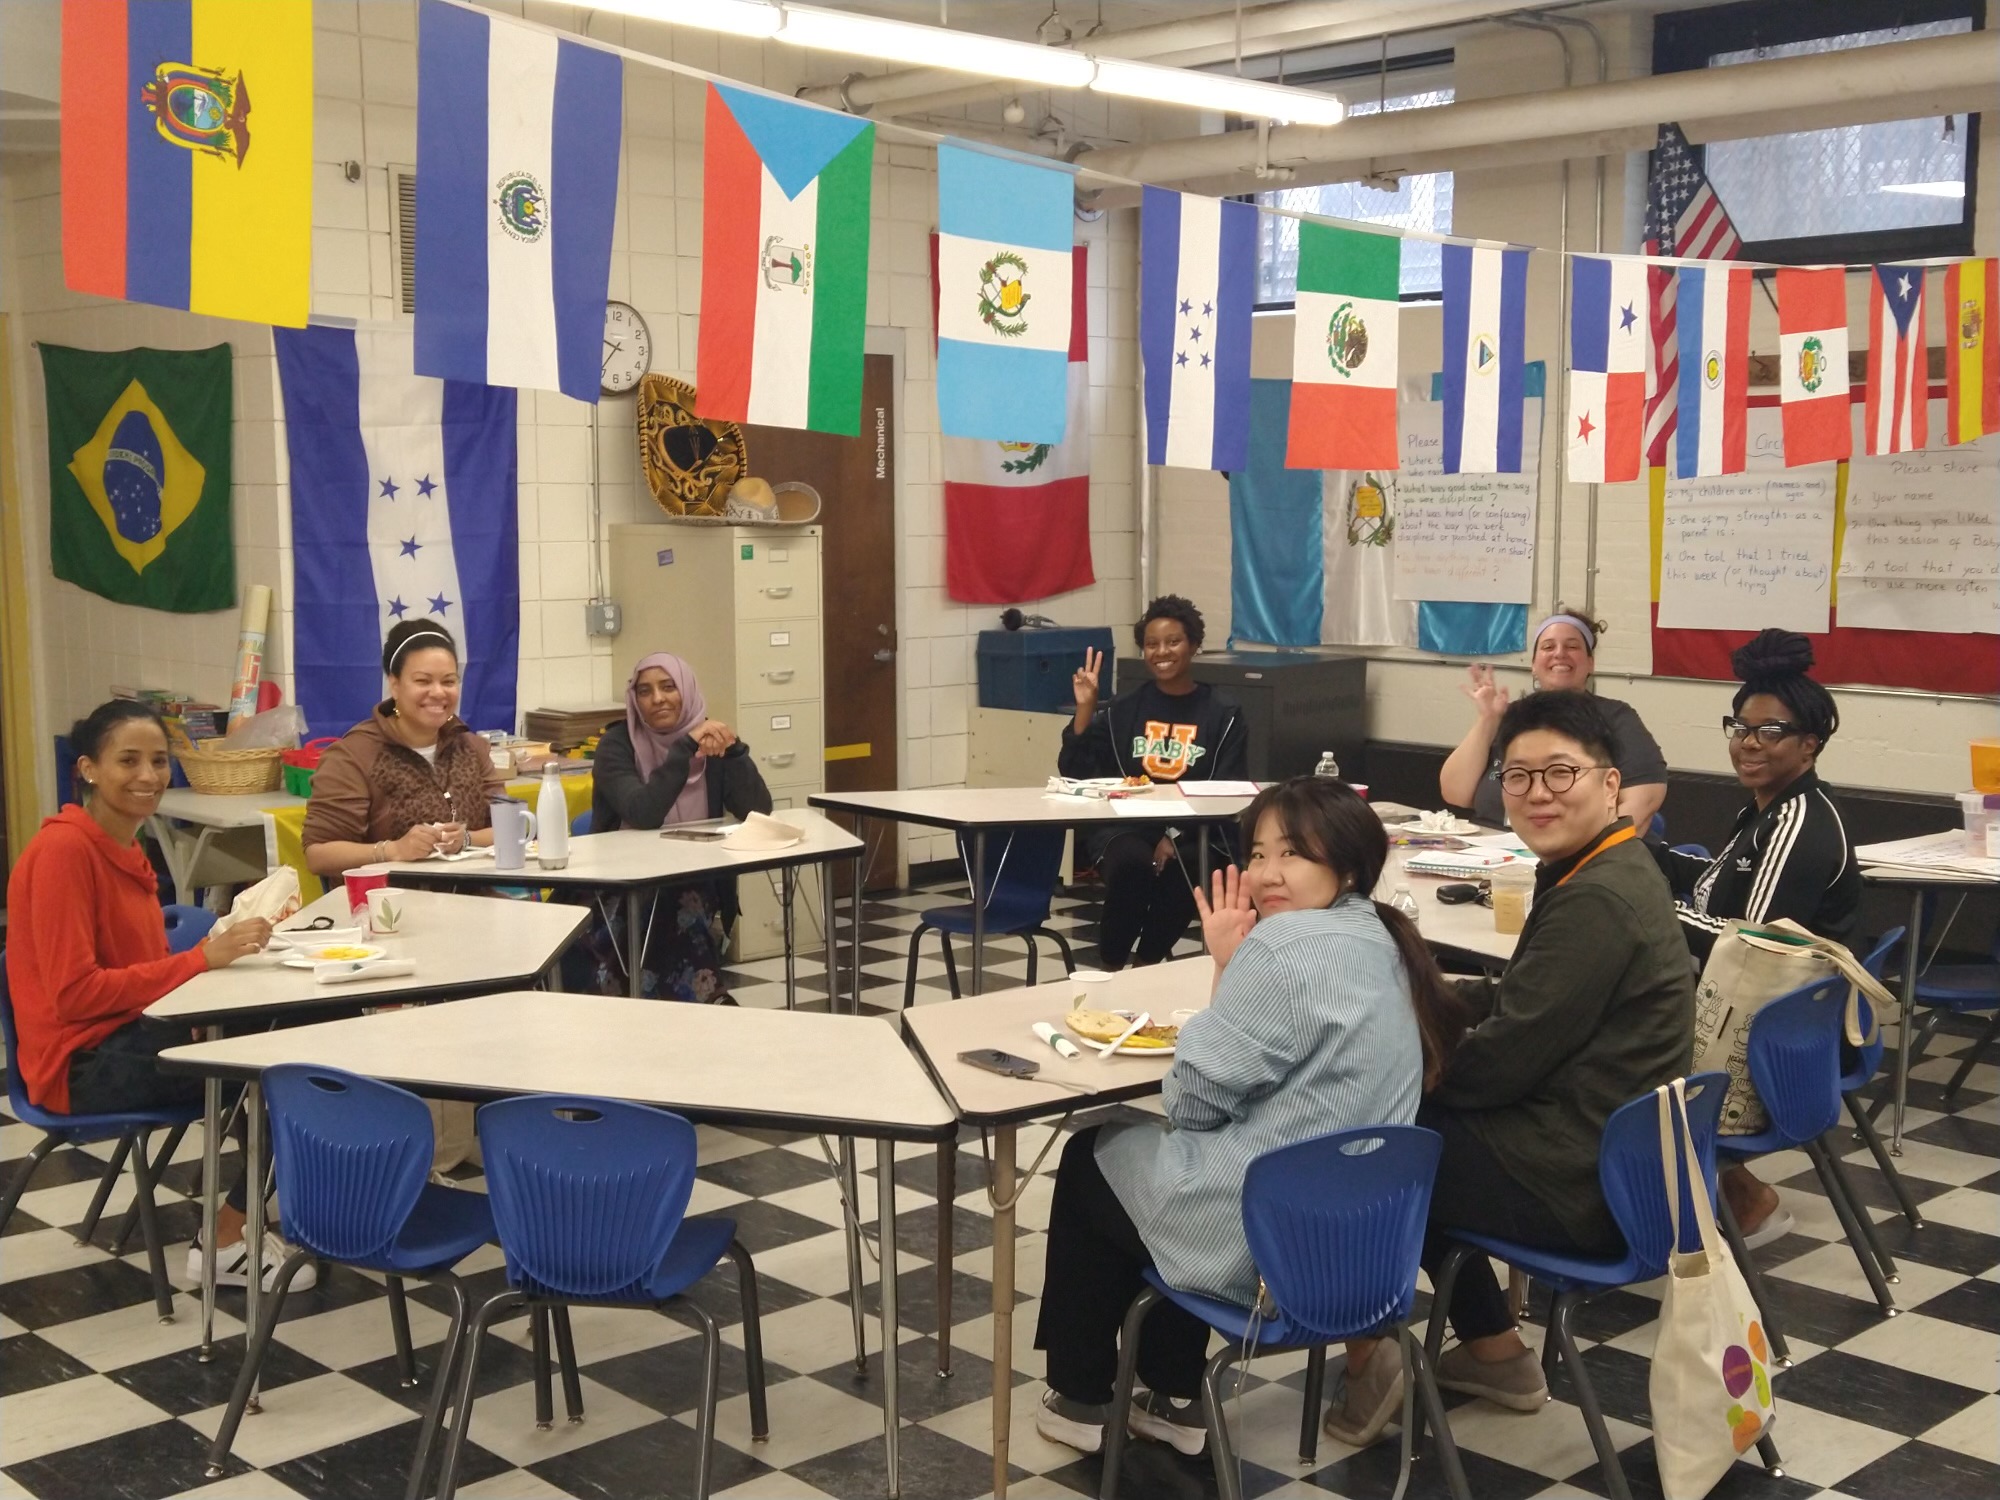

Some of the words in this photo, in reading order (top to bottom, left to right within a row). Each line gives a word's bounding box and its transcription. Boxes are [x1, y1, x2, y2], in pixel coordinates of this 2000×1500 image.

[612, 311, 622, 321] 12
[628, 316, 632, 327] 1
[635, 330, 642, 340] 2
[638, 346, 645, 356] 3
[634, 361, 641, 370] 4
[612, 374, 619, 384] 6
[625, 372, 632, 381] 5
[875, 408, 885, 479] Mechanical
[1408, 434, 1439, 448] Please
[1891, 460, 1932, 474] Please
[1404, 484, 1425, 494] What
[1430, 485, 1445, 493] was
[1447, 483, 1466, 496] good
[1470, 483, 1491, 491] about
[1513, 483, 1530, 495] way
[1680, 488, 1694, 502] My
[1699, 485, 1735, 496] children
[1785, 491, 1804, 501] ages
[1904, 491, 1933, 501] name
[1404, 497, 1415, 508] you
[1490, 493, 1498, 507] ?
[1404, 509, 1423, 519] What
[1445, 508, 1463, 517] hard
[1680, 514, 1696, 524] One
[1702, 515, 1712, 526] of
[1716, 515, 1728, 527] my
[1737, 508, 1786, 526] strengths
[1813, 512, 1823, 520] a
[1400, 521, 1422, 530] about
[1428, 521, 1439, 529] the
[1444, 523, 1460, 532] way
[1465, 523, 1480, 533] you
[1484, 522, 1504, 531] were
[1868, 517, 1887, 527] One
[1894, 515, 1921, 532] thing
[1932, 518, 1949, 530] you
[1452, 533, 1486, 546] punished
[1491, 533, 1501, 542] at
[1506, 533, 1527, 544] home
[1681, 528, 1708, 543] parent
[1866, 532, 1889, 545] this
[1898, 535, 1939, 545] session
[1949, 538, 1961, 550] of
[1679, 550, 1695, 562] One
[1704, 550, 1725, 562] tool
[1736, 548, 1758, 561] that
[1780, 548, 1811, 561] tried
[1864, 560, 1875, 572] A
[1884, 560, 1908, 572] tool
[1922, 560, 1953, 572] that
[1667, 568, 1687, 579] this
[1749, 565, 1786, 582] thought
[1737, 580, 1767, 595] trying
[1862, 577, 1877, 588] to
[1887, 581, 1905, 589] use
[1916, 581, 1946, 591] more
[1956, 579, 1988, 597] often
[1132, 736, 1207, 767] BABY
[1142, 721, 1198, 780] U
